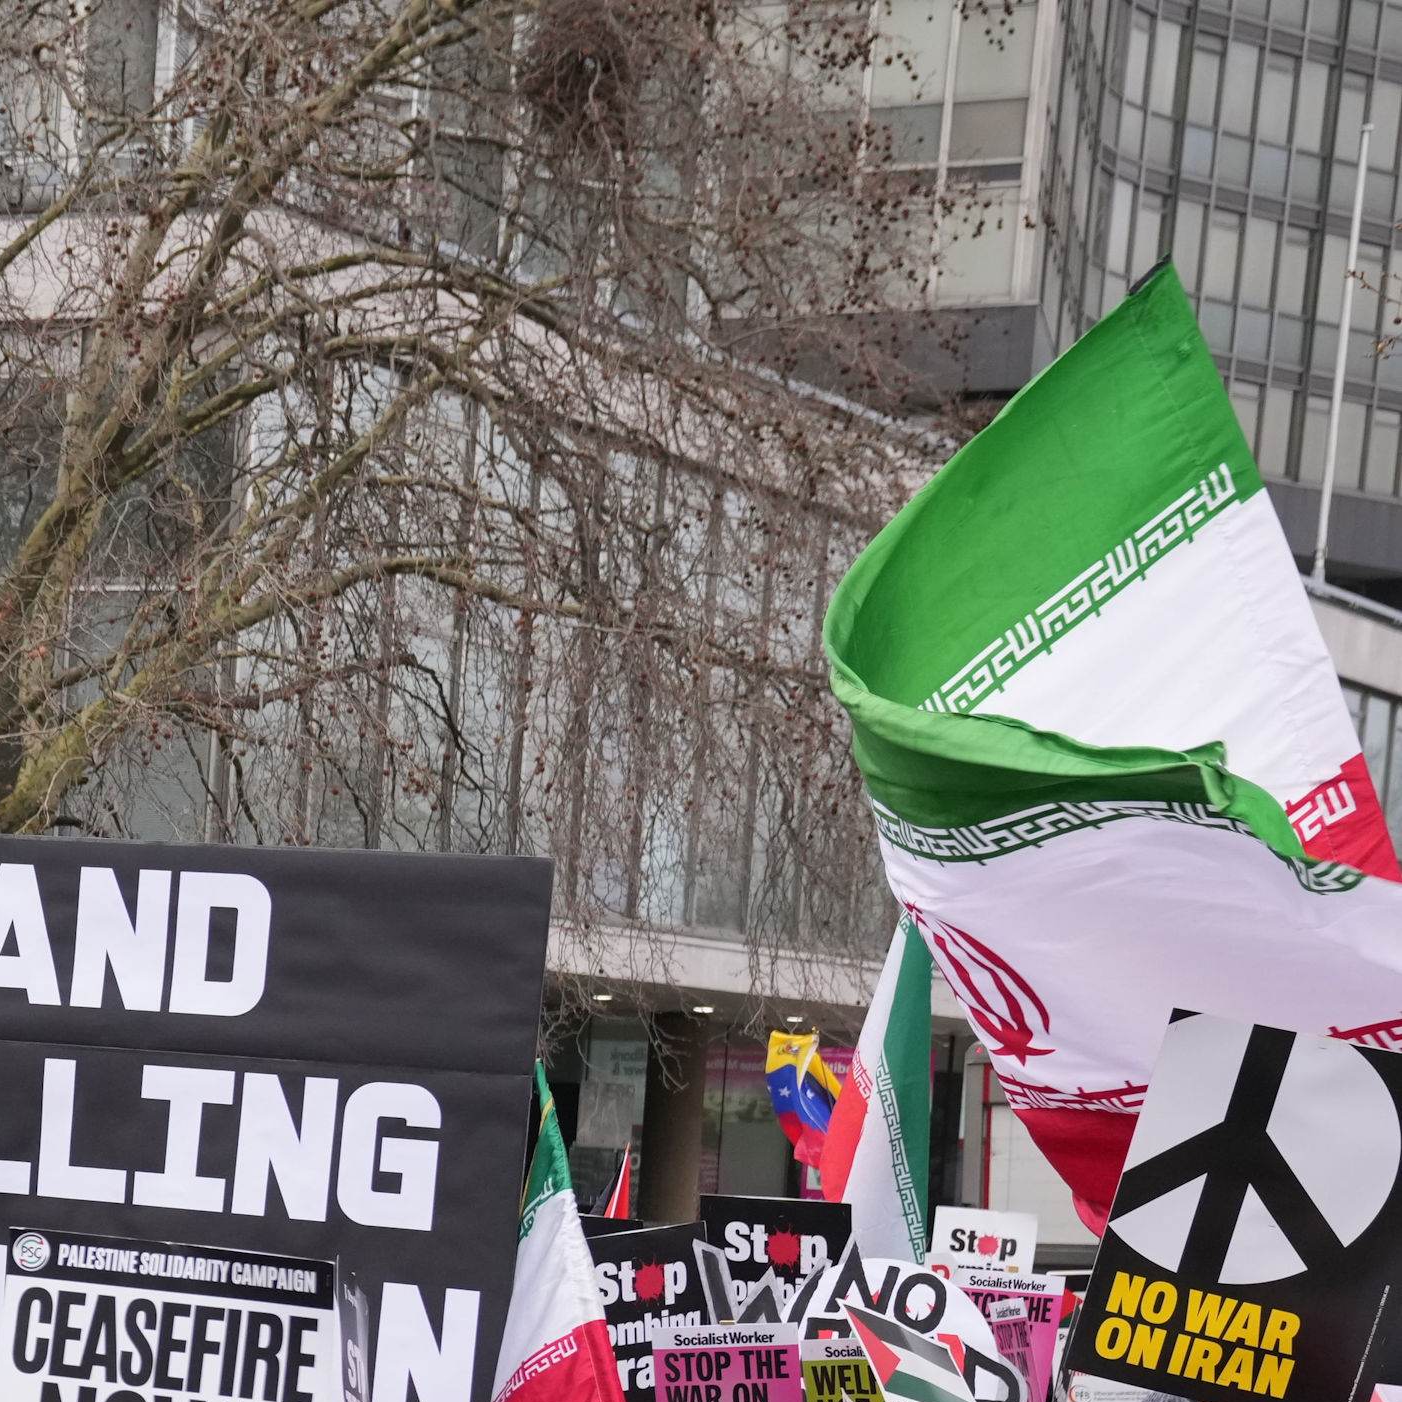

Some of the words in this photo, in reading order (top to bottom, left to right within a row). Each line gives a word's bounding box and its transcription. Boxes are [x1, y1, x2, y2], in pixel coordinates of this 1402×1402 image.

[21, 1246, 41, 1259] PSC
[58, 1242, 139, 1274] PALESTINE
[140, 1251, 229, 1285] SOLIDARITY
[231, 1262, 317, 1294] CAMPAIGN
[969, 1275, 1013, 1291] Socialist
[1013, 1277, 1047, 1292] Worker
[1105, 1271, 1178, 1325] NO
[1184, 1288, 1301, 1356] WAR
[674, 1333, 728, 1346] Socialist
[729, 1332, 775, 1344] Worker
[664, 1350, 731, 1382] STOP
[735, 1349, 789, 1380] THE
[1095, 1317, 1168, 1370] ON
[1167, 1334, 1295, 1400] IRAN
